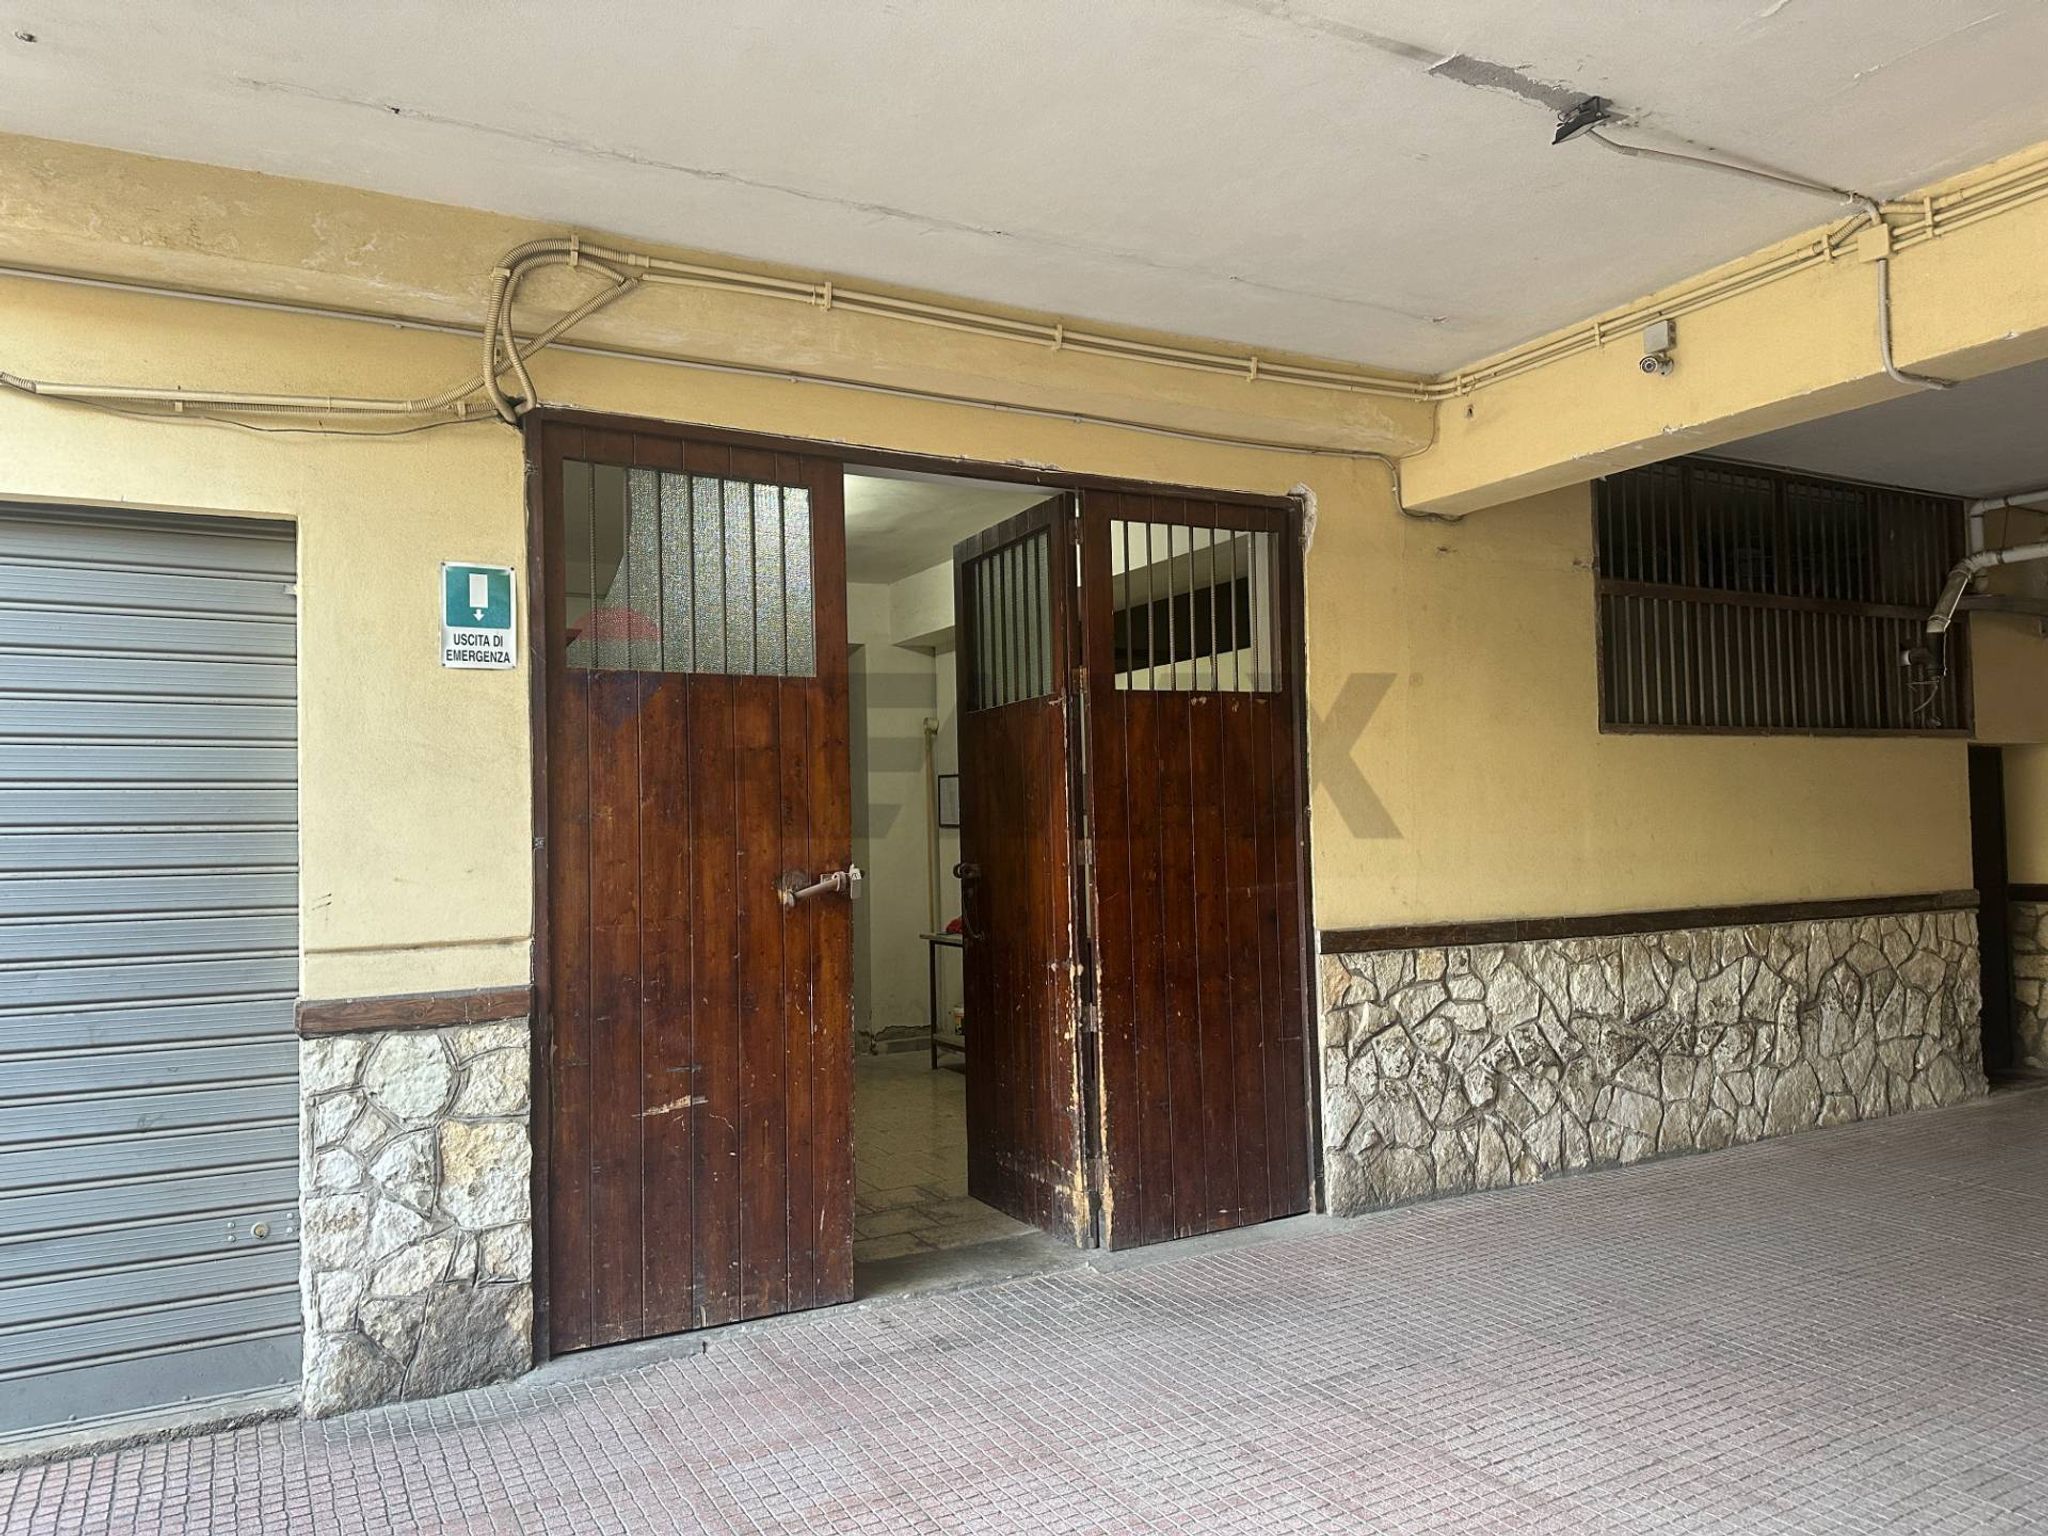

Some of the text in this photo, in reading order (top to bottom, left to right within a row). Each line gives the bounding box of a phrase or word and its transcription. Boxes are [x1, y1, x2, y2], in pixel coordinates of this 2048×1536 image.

[453, 633, 504, 647] USCITA DI
[446, 649, 511, 663] EMERGENZA
